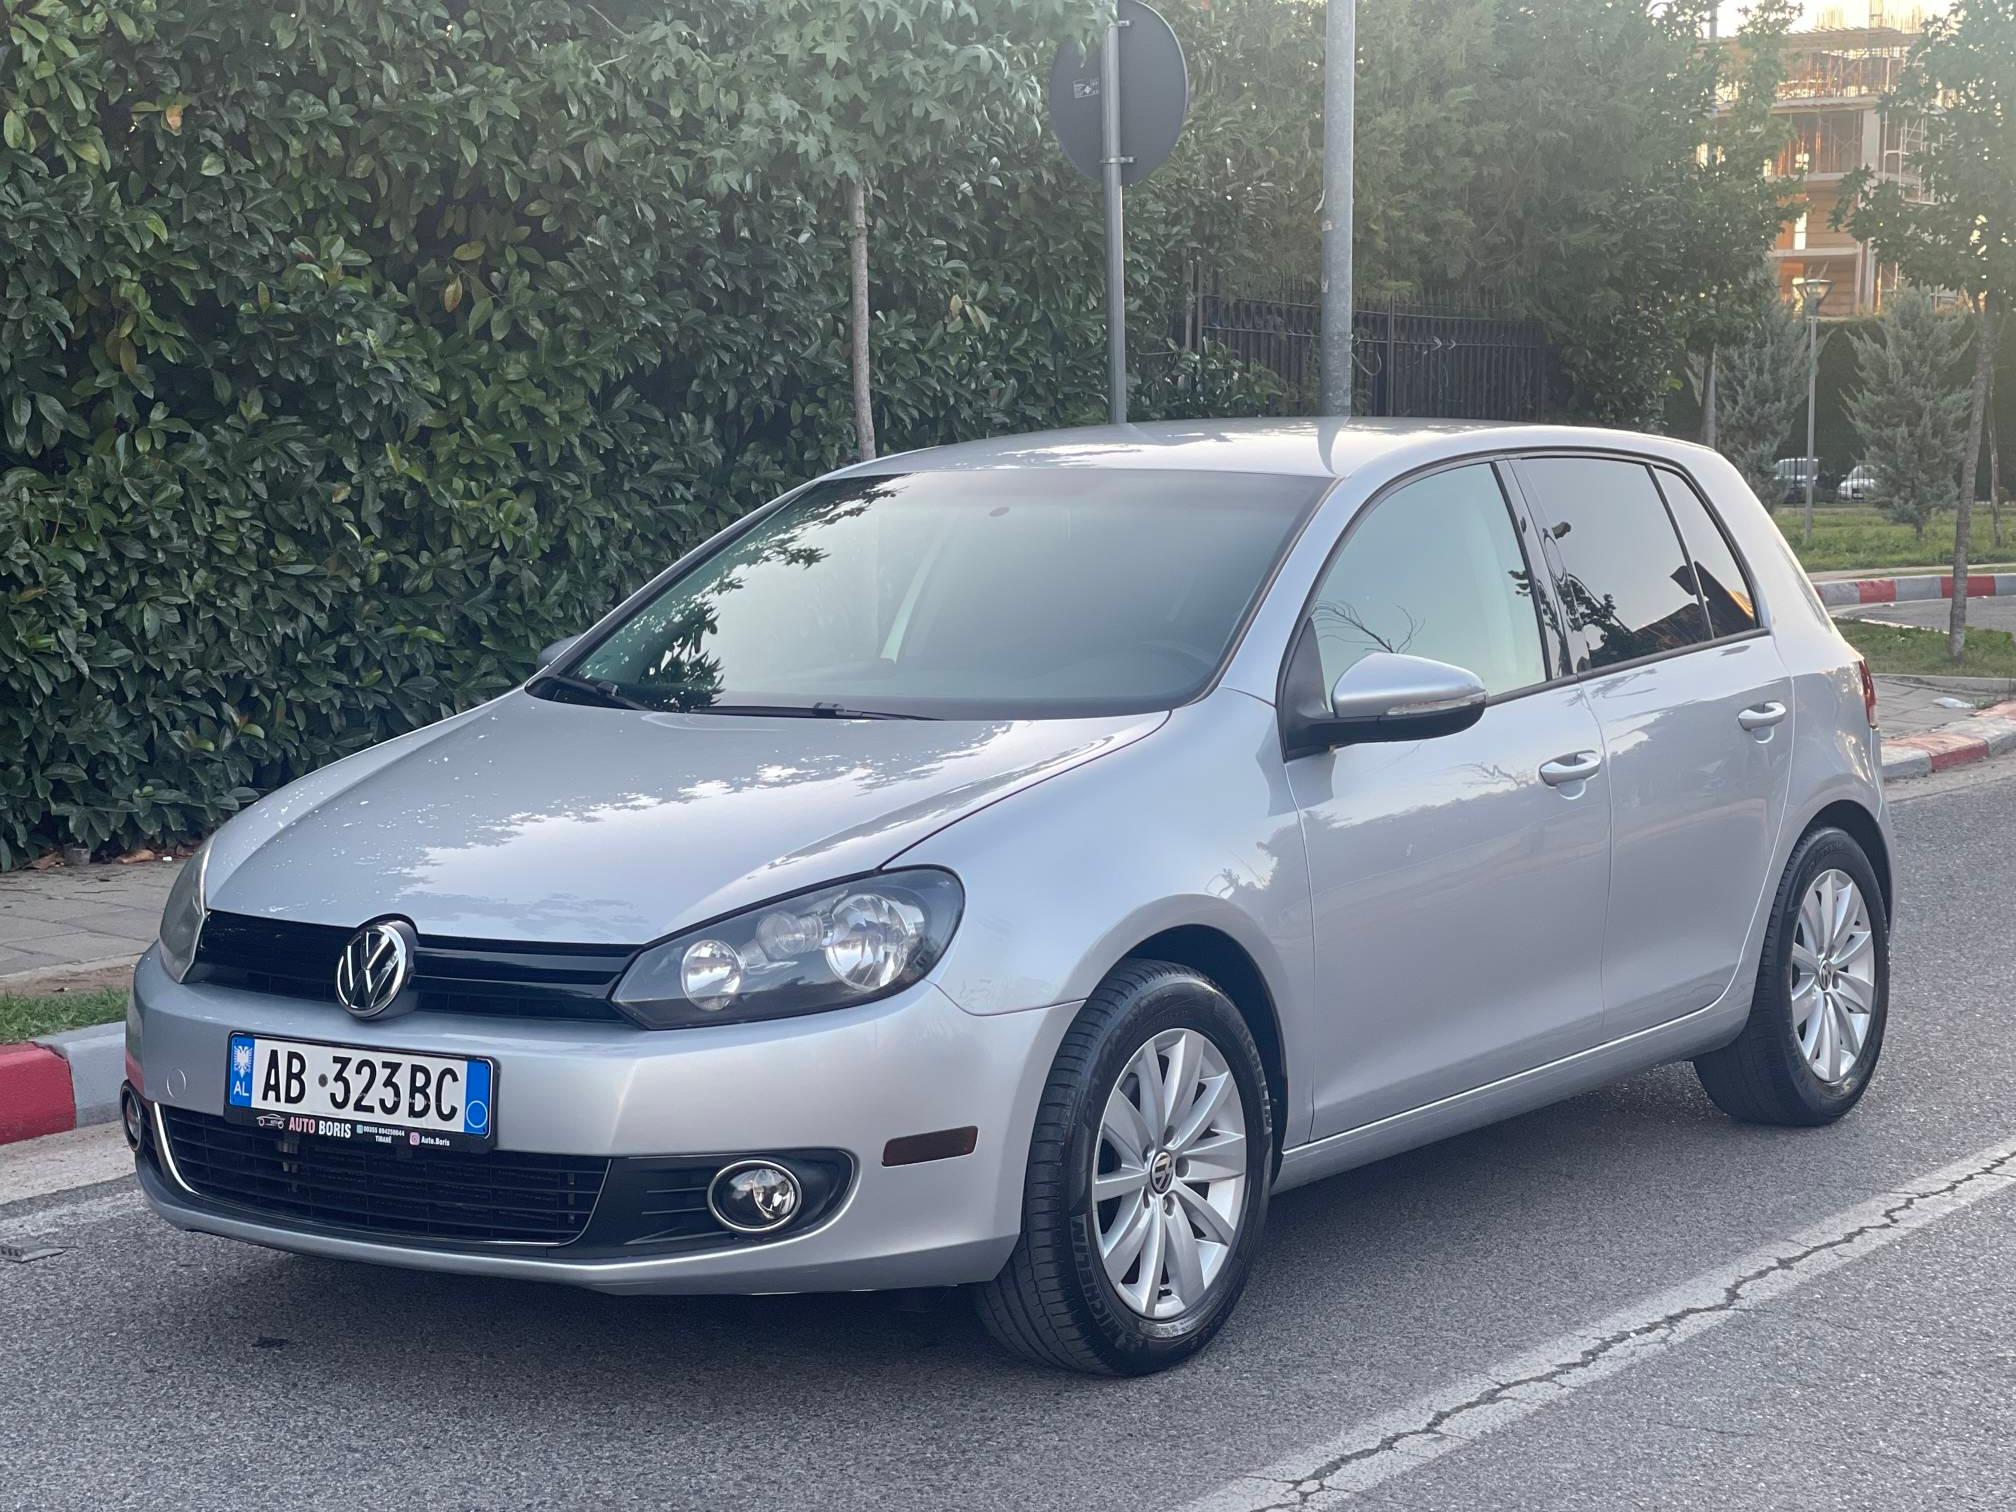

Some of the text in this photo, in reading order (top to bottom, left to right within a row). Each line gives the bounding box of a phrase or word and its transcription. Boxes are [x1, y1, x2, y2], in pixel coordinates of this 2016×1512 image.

[261, 1049, 307, 1104] AB
[233, 1081, 250, 1097] AL
[289, 1117, 352, 1138] AUTO BORIS
[421, 1135, 450, 1147] Auto.Boris
